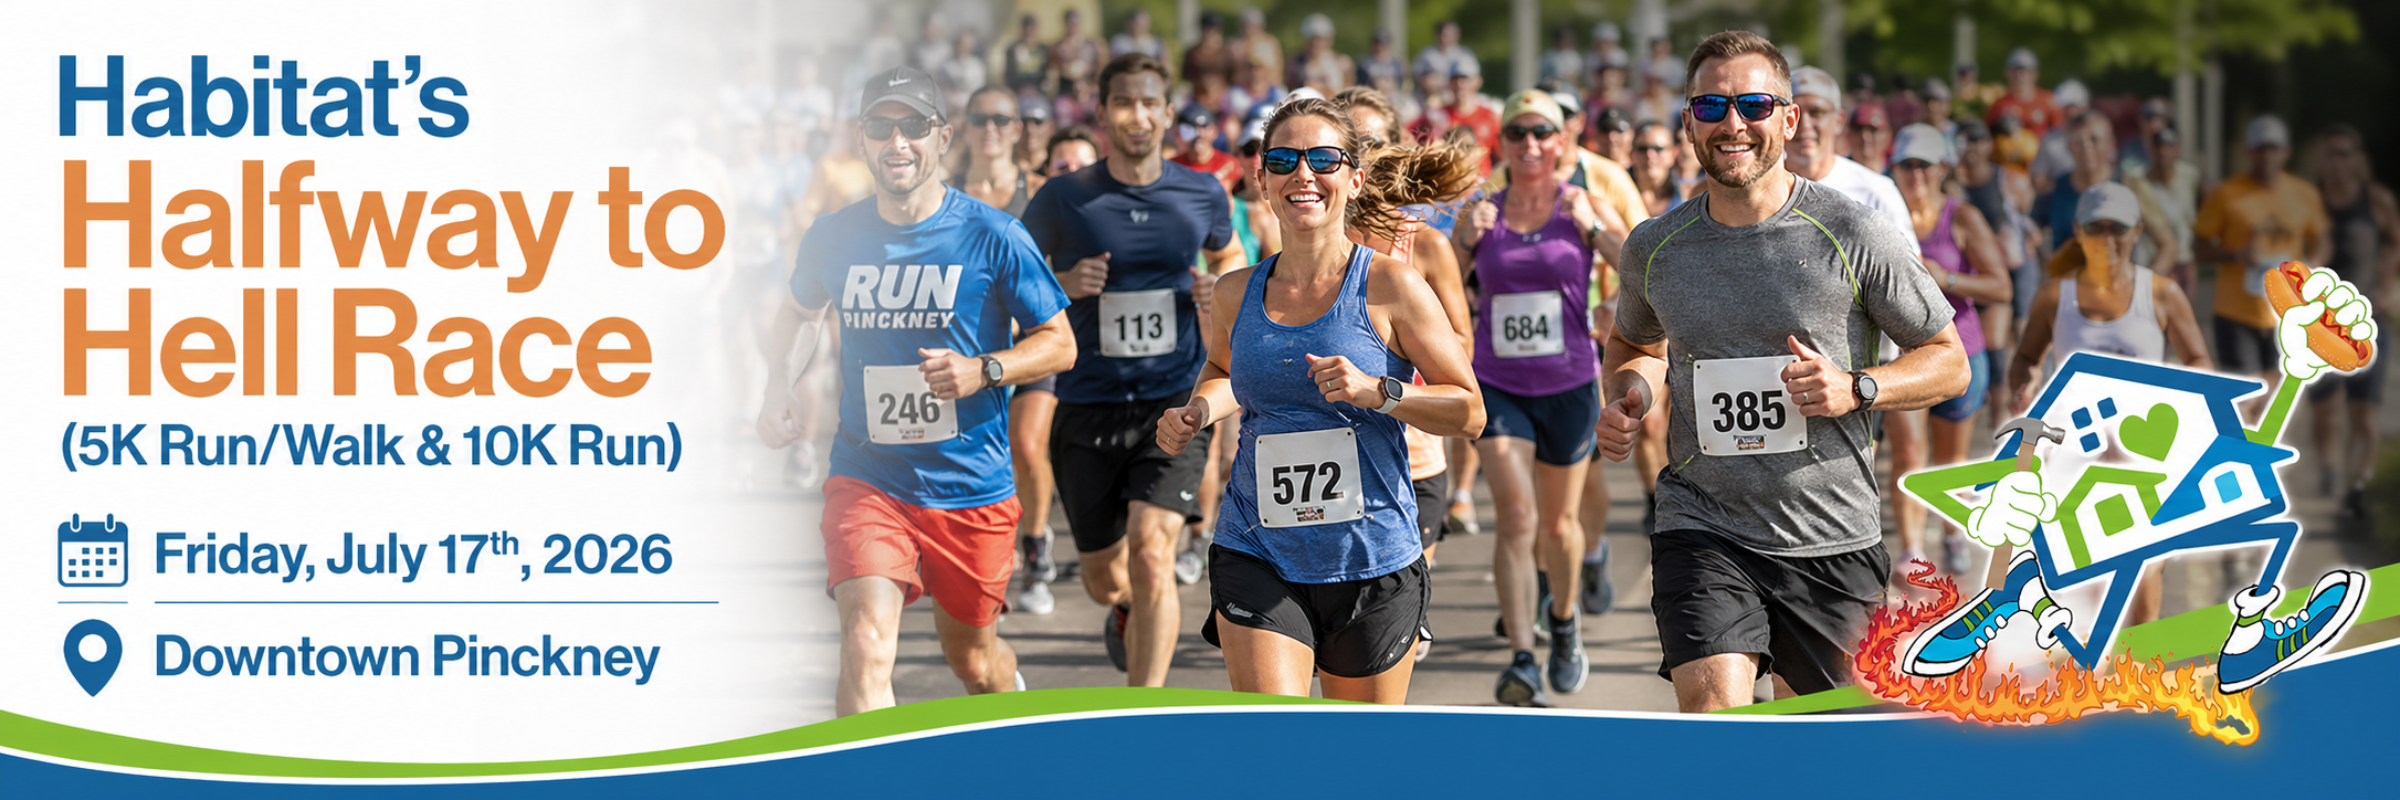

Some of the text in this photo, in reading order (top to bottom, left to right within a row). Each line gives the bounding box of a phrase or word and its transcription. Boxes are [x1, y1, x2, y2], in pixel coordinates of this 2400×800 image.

[842, 265, 963, 309] RUN
[843, 311, 955, 329] PINCKNEY
[1114, 313, 1163, 341] 113
[1504, 315, 1549, 342] 684
[879, 392, 940, 425] 246
[1712, 390, 1786, 432] 385
[1272, 461, 1344, 505] 572
